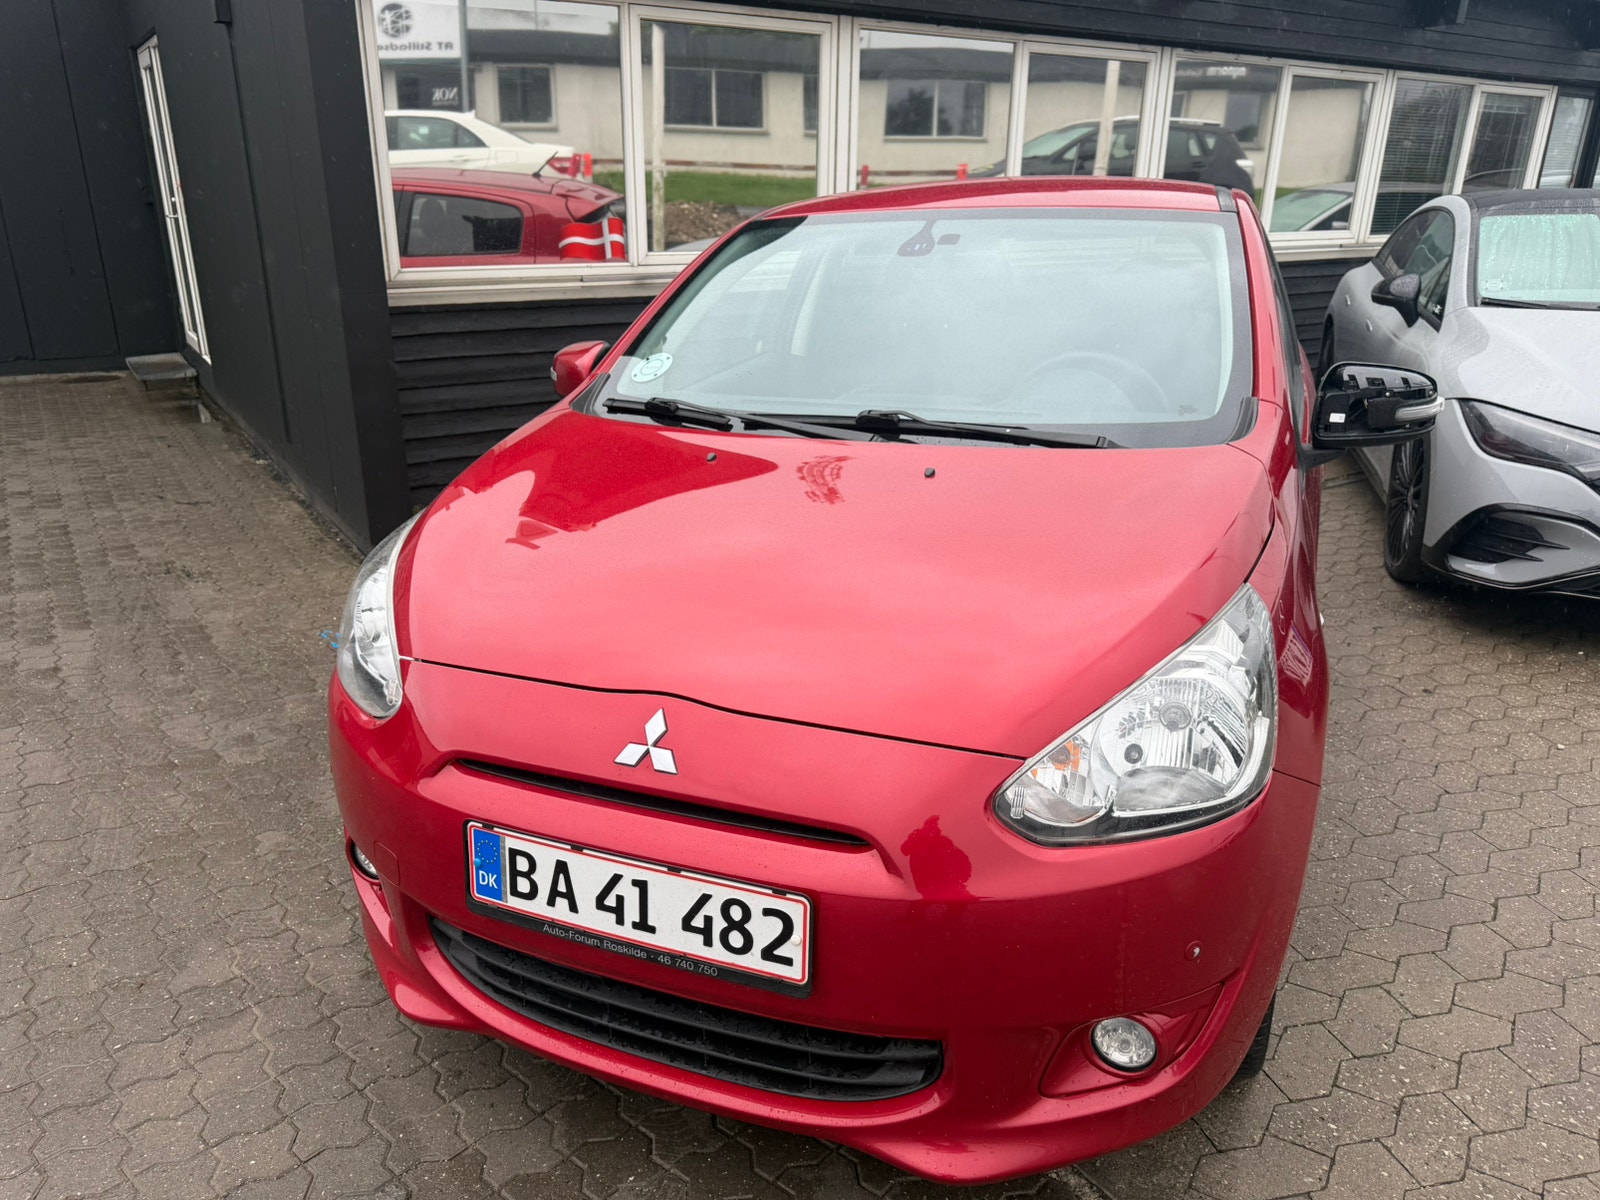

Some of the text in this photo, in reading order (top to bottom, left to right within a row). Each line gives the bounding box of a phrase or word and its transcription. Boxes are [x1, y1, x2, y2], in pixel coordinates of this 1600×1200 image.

[478, 870, 498, 889] DK
[508, 847, 794, 967] BA 41 482
[543, 923, 718, 977] Auto-Forum Roskilde 46 740 750
